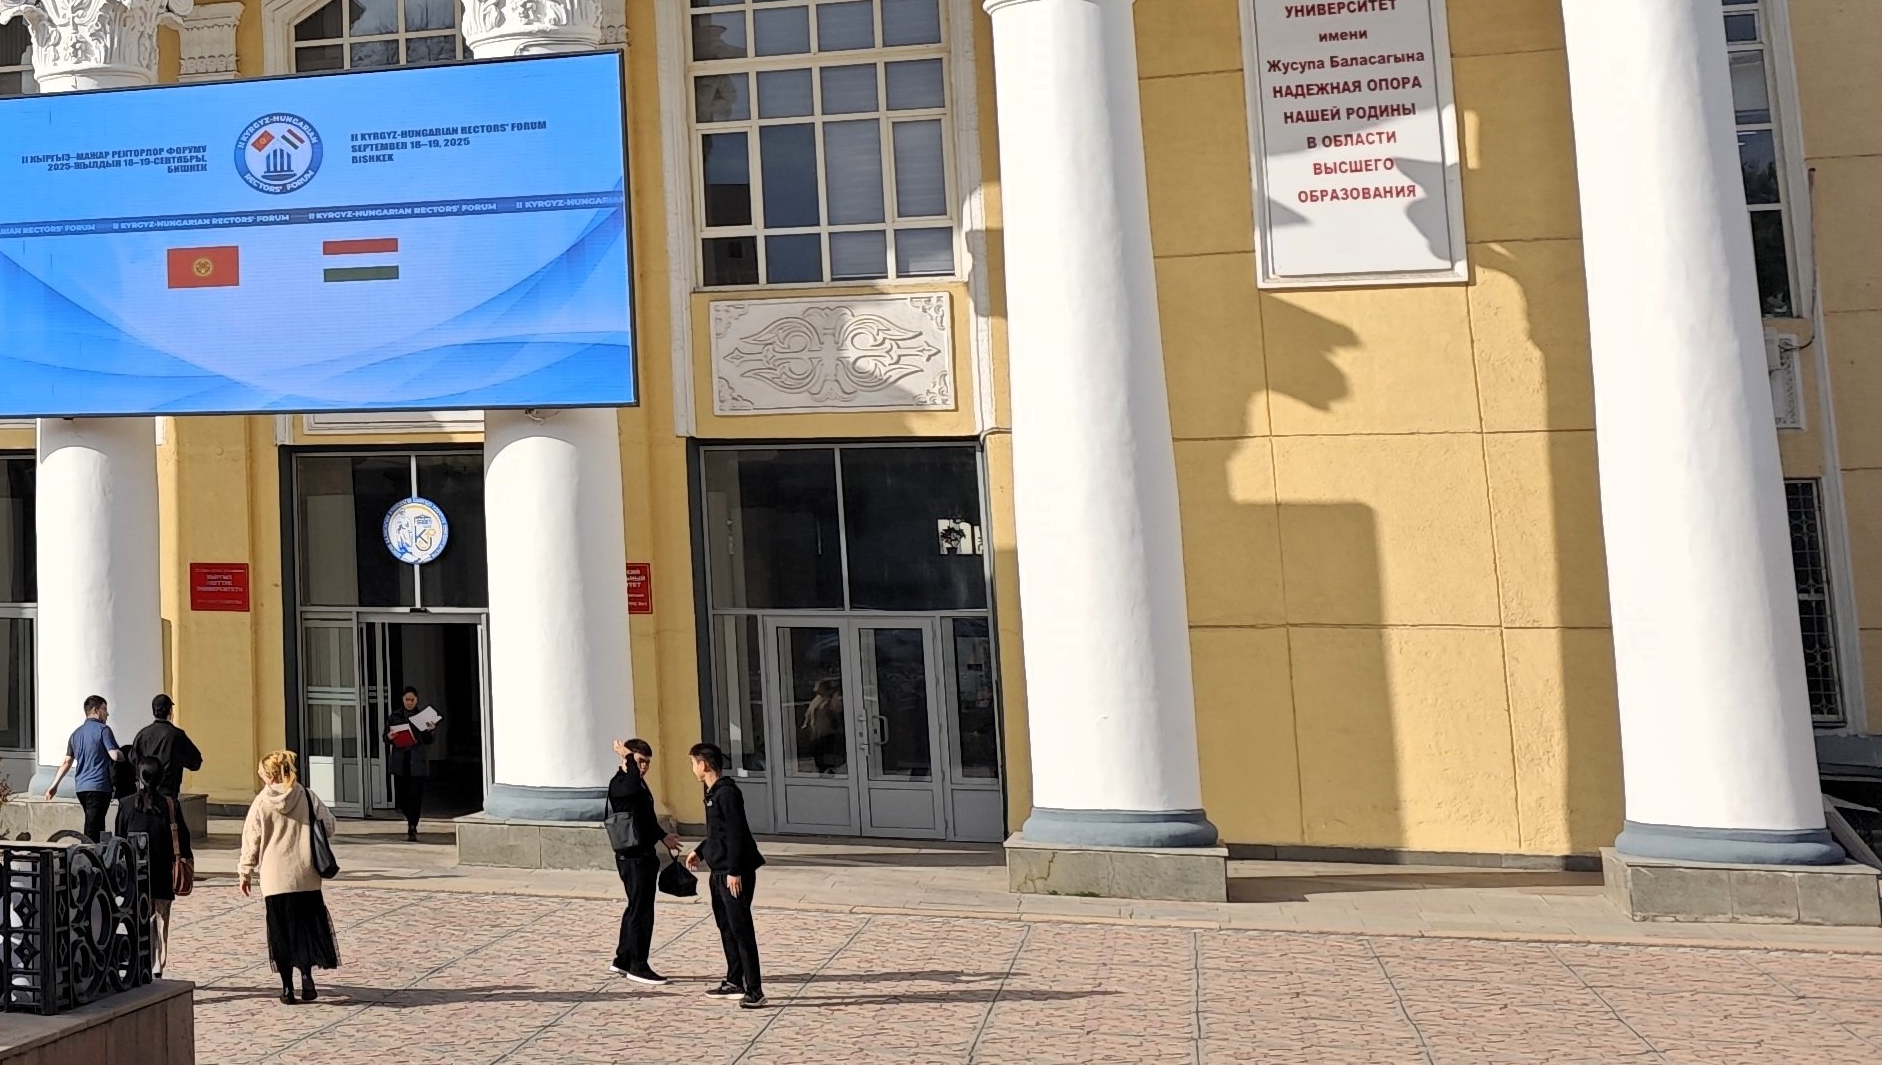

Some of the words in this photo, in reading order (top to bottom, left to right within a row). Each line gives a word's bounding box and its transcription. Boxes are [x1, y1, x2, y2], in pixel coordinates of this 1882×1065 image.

[1319, 29, 1368, 43] имени
[1267, 58, 1325, 76] Жусупа
[1330, 50, 1425, 71] Баласагына
[1273, 80, 1362, 100] НАДЕЖНАЯ
[1367, 75, 1422, 93] ОПОРА
[1283, 105, 1341, 125] НАШЕЙ
[1346, 102, 1416, 121] РОДИНЫ
[351, 133, 358, 142] II
[360, 126, 459, 142] KYRGYZ-HUNGARIAN
[510, 120, 547, 131] FORUM
[1307, 135, 1317, 149] В
[1321, 131, 1397, 148] ОБЛАСТИ
[351, 141, 408, 153] SEPTEMBER
[443, 137, 470, 147] 2025
[351, 153, 394, 164] BISHKEK
[1313, 157, 1395, 175] ВЫСШЕГО
[286, 169, 315, 191] FORUM
[1298, 184, 1416, 203] ОБРАЗОВАНИЯ
[256, 214, 290, 223] FORUM
[316, 207, 412, 219] KYRGYZ-HUNGARIAN
[461, 202, 497, 212] FORUM
[65, 223, 95, 232] FORUM
